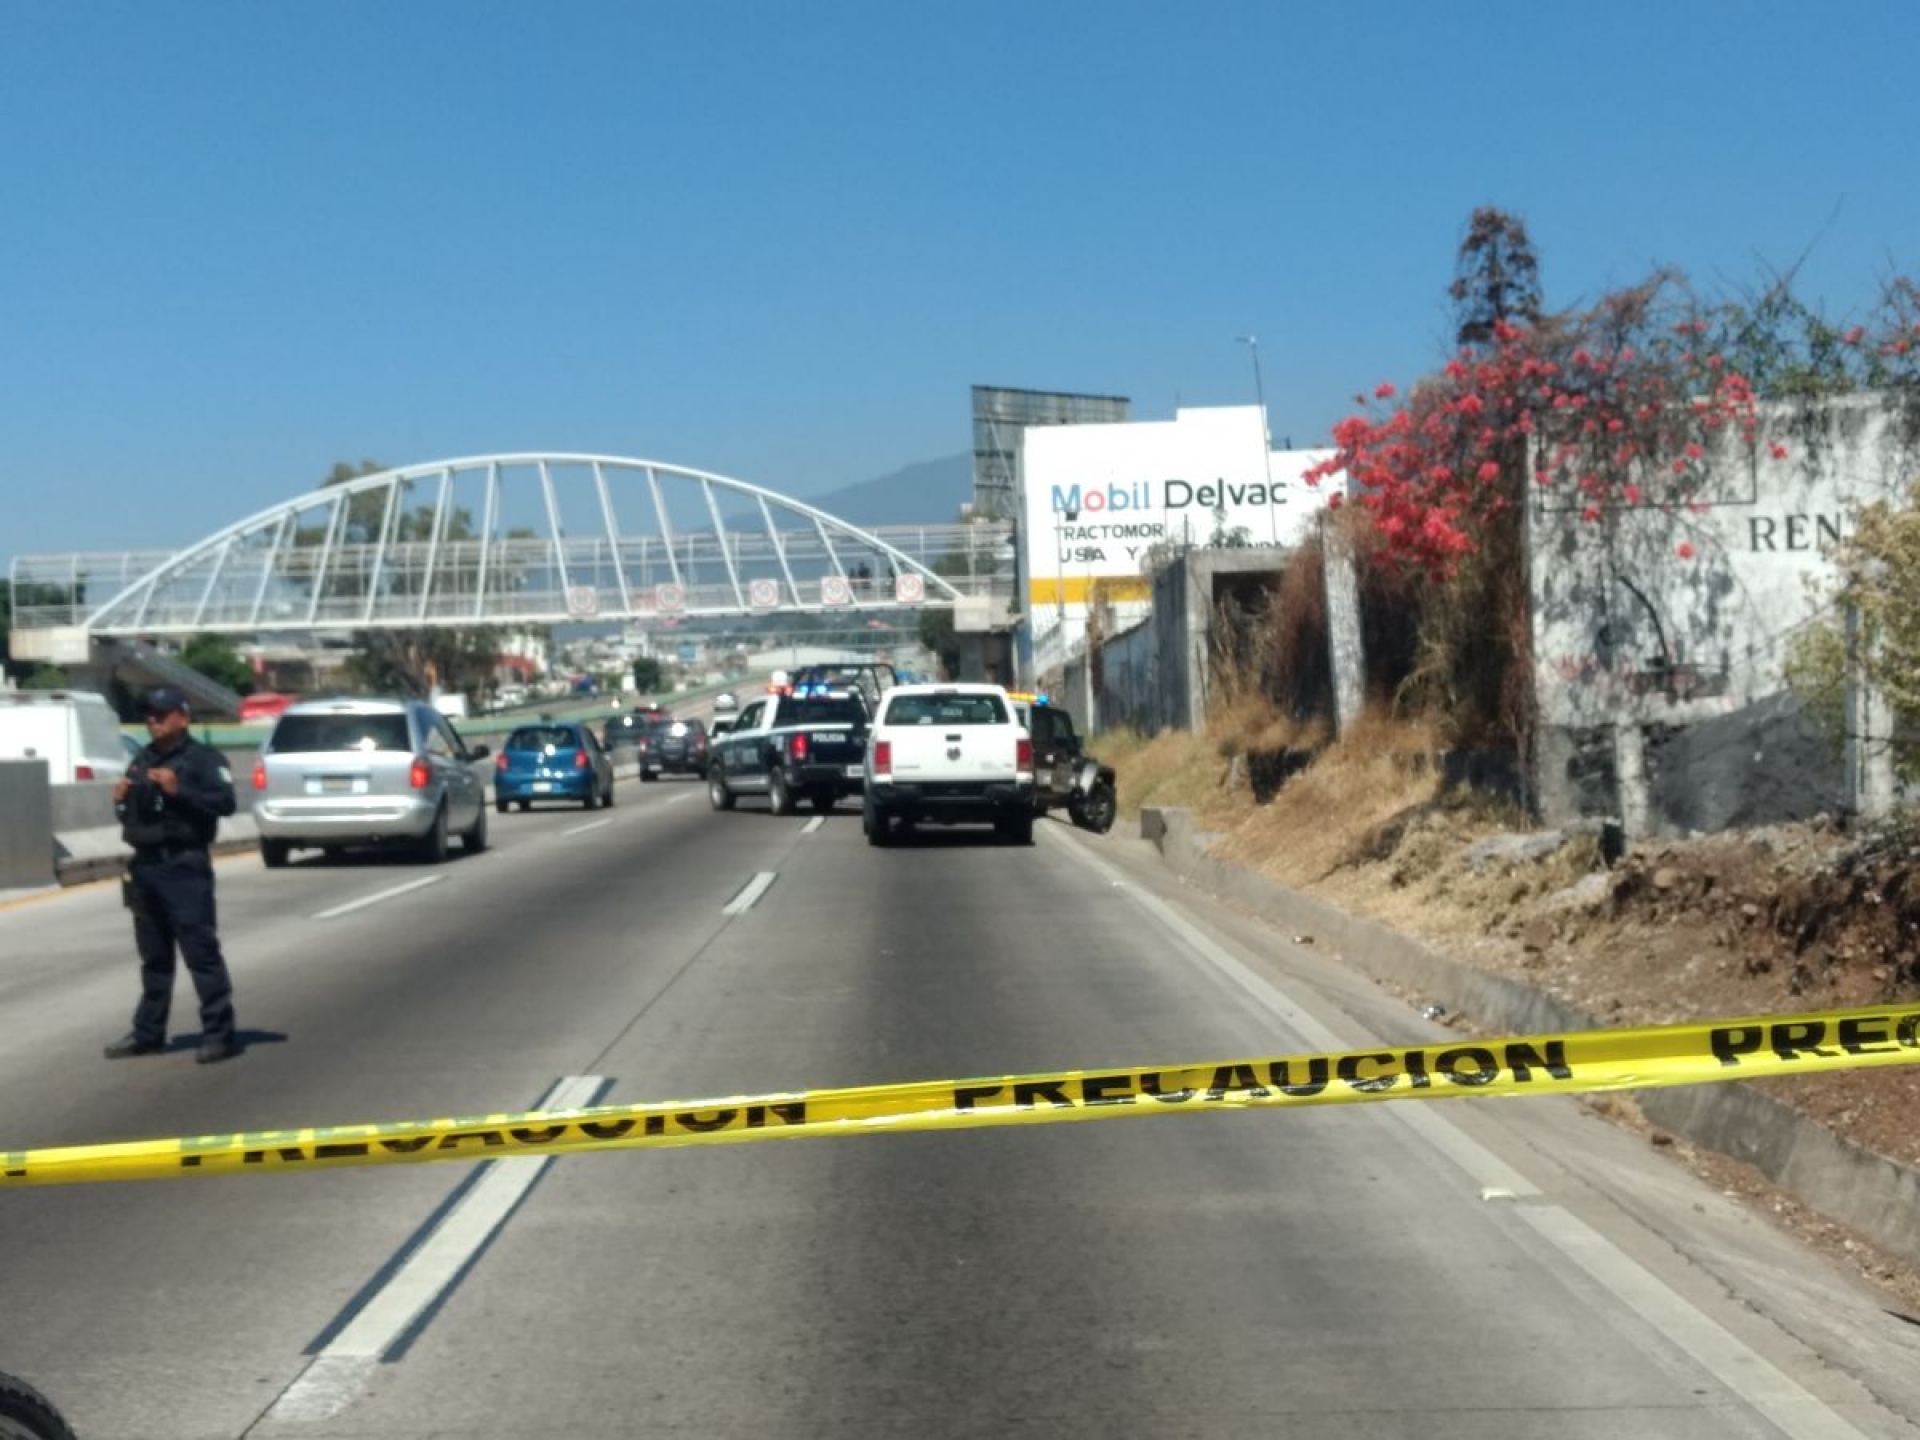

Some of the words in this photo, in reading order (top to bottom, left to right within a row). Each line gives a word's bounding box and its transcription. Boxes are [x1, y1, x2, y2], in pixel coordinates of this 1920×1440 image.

[1051, 482, 1150, 512] Mobil
[1164, 478, 1288, 509] Delvac
[954, 1040, 1572, 1114] PRECAUCION
